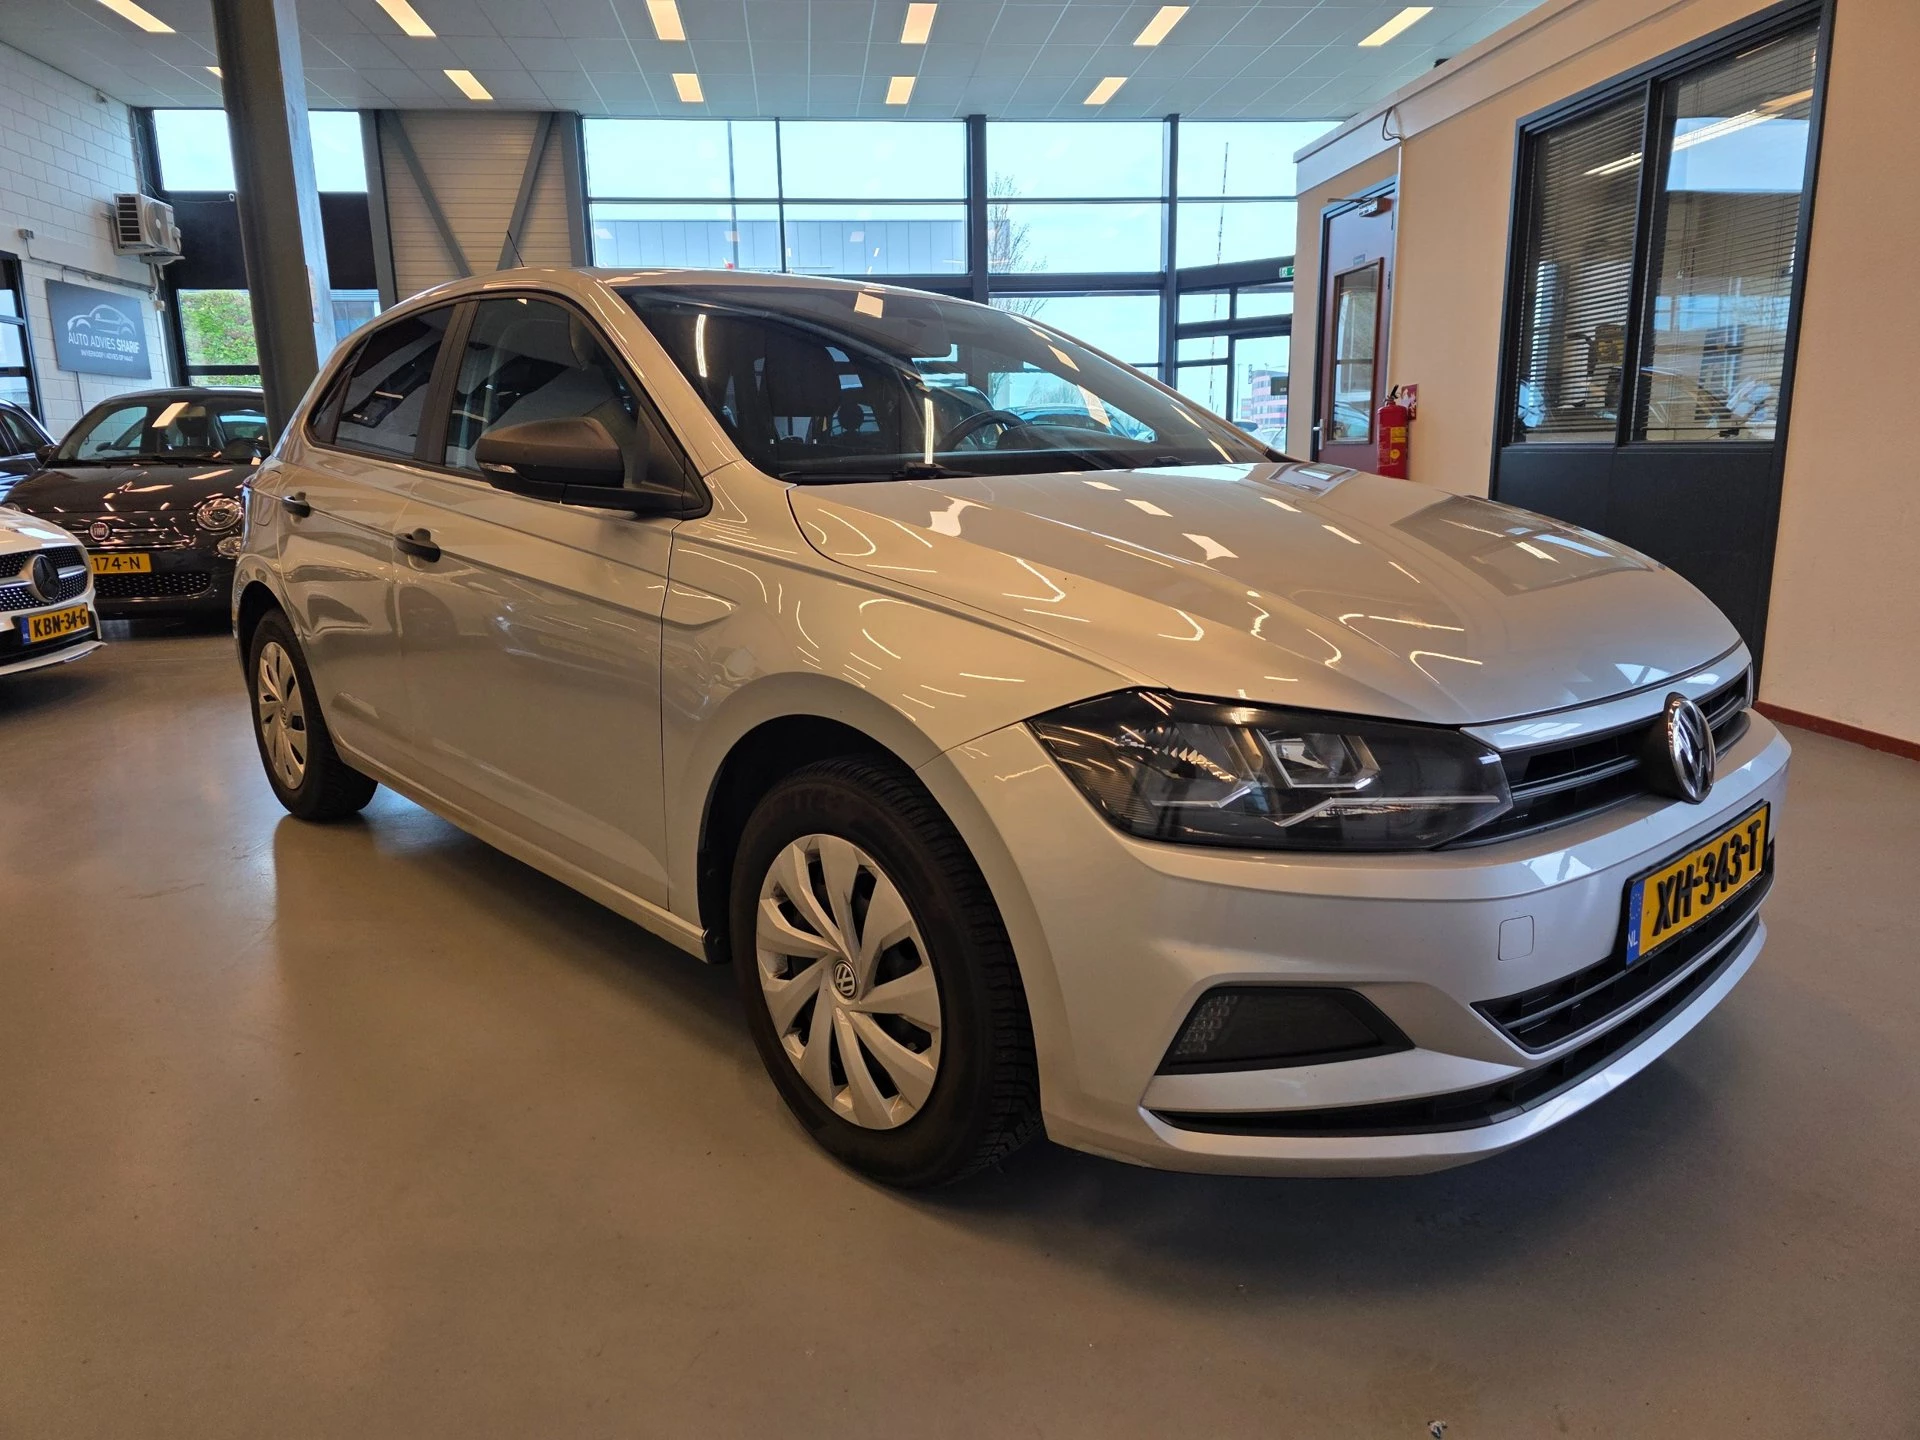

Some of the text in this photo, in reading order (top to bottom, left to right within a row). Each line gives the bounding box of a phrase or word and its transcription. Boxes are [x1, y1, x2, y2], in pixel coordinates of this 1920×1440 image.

[68, 331, 89, 346] AUTO
[90, 335, 116, 350] ADVIES
[91, 555, 141, 571] 174-N
[33, 608, 87, 638] KBN-34-G
[1652, 819, 1762, 936] XH-343-T
[1627, 929, 1638, 948] NL
